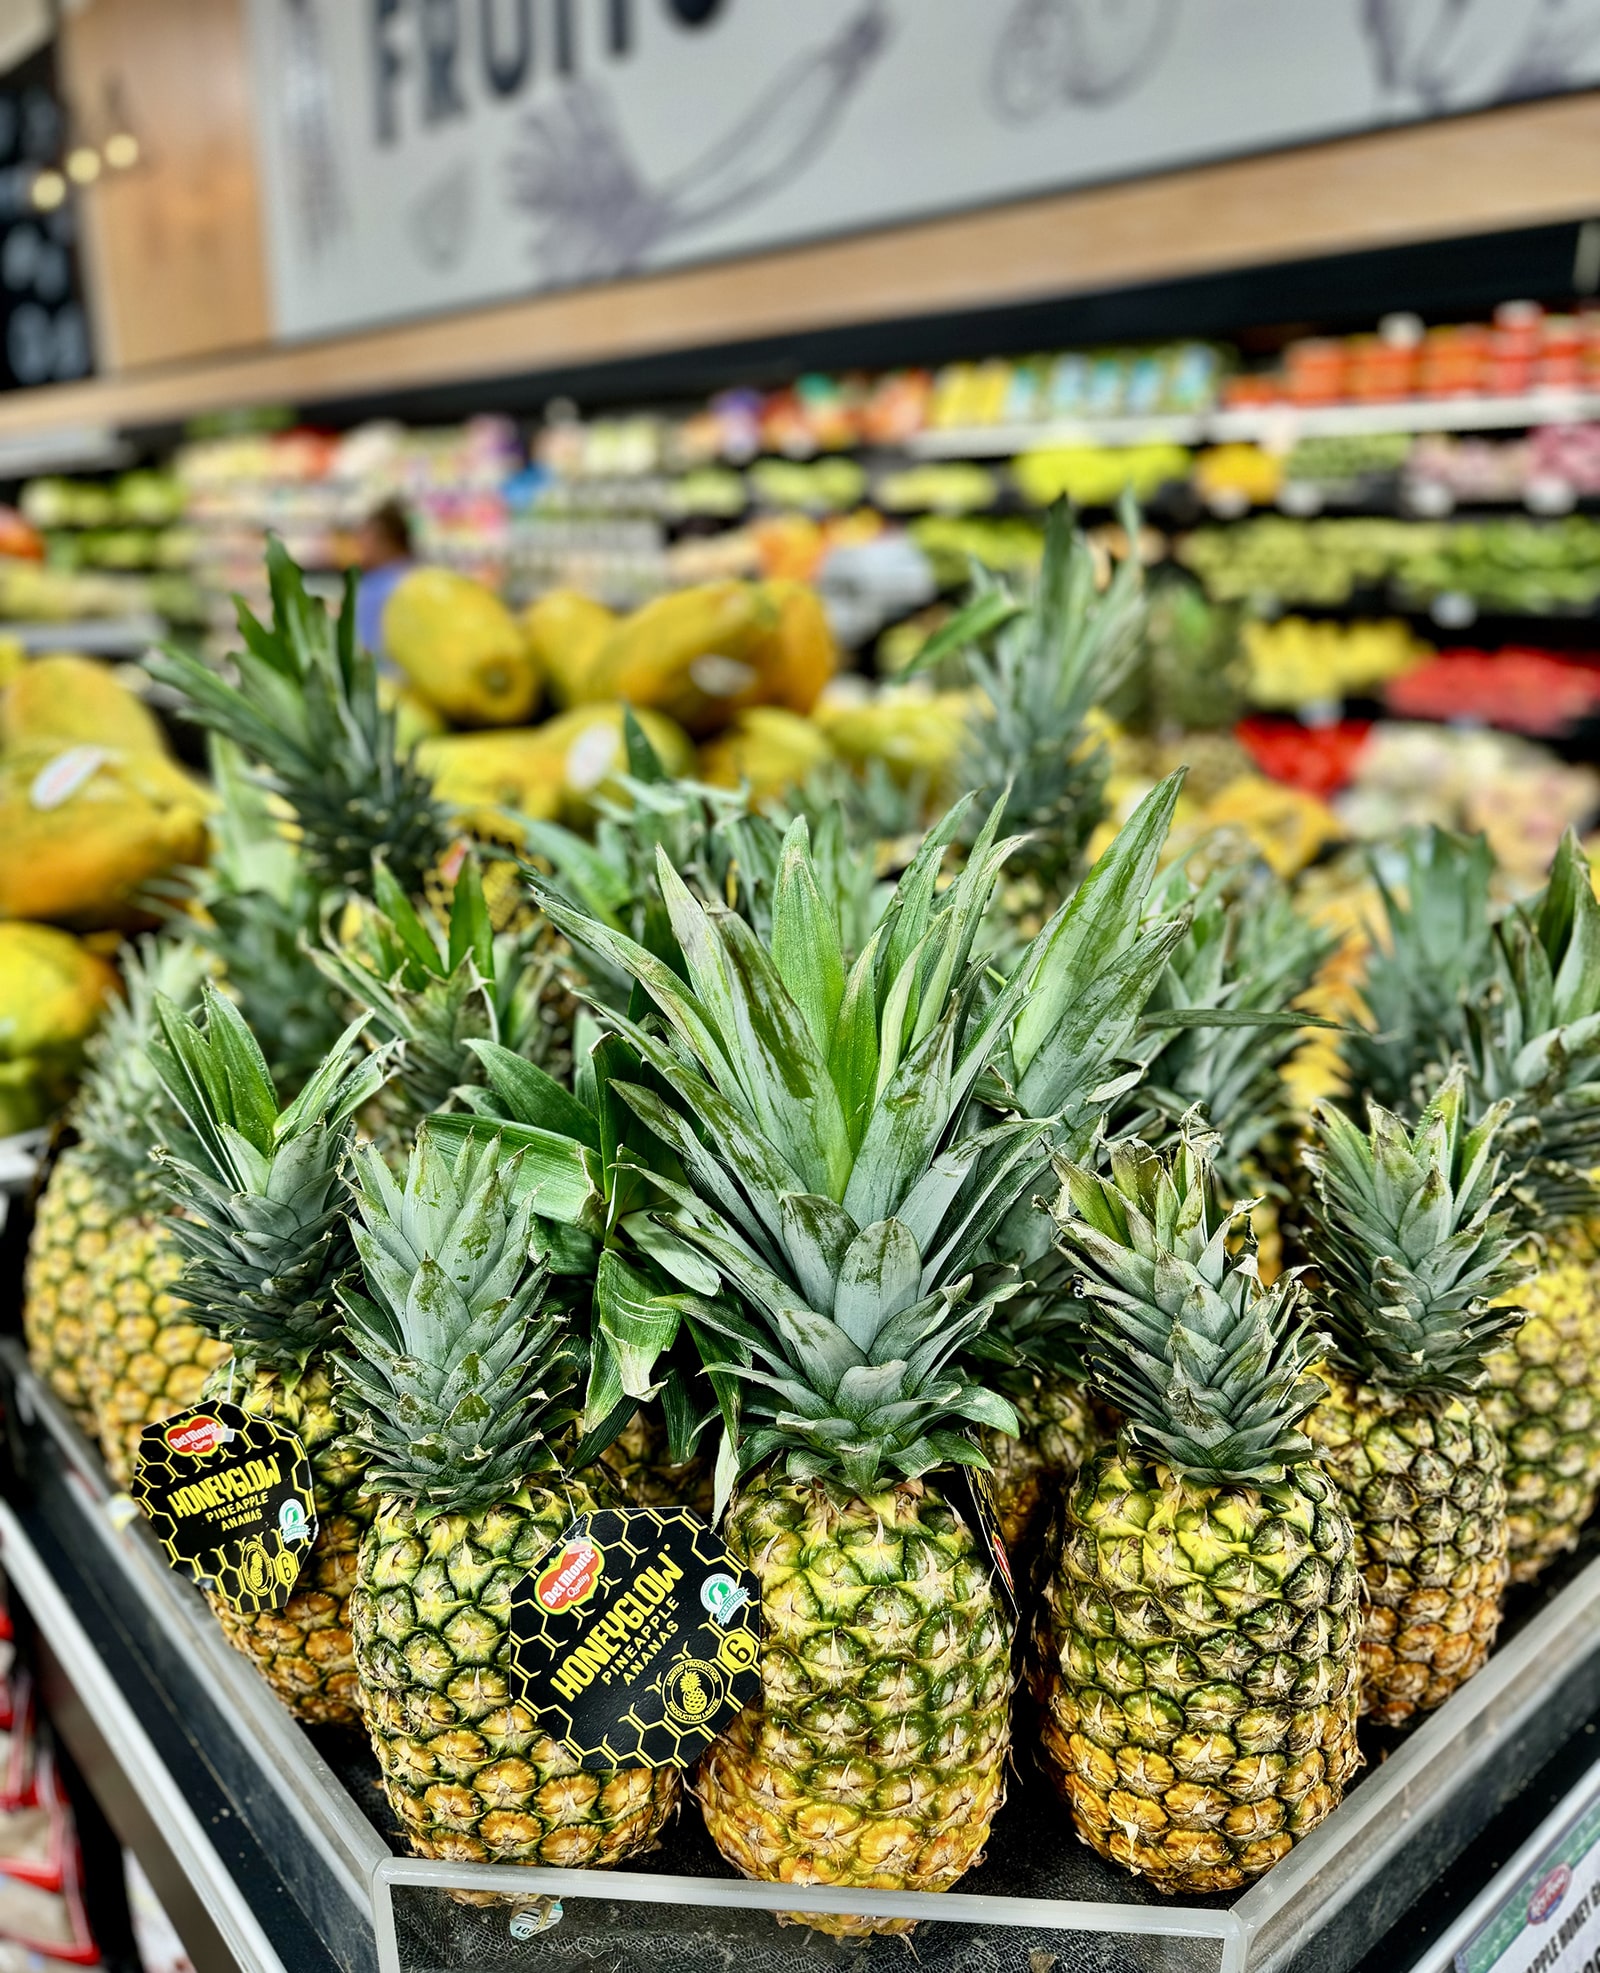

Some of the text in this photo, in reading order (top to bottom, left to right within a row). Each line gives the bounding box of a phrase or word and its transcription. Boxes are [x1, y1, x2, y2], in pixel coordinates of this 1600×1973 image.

[373, 0, 730, 147] FRUI
[170, 1422, 218, 1449] Del Monte
[167, 1455, 282, 1519] HONEYGLOW
[205, 1491, 269, 1522] PINEAPPLE
[221, 1508, 263, 1532] ANANAS
[281, 1556, 292, 1579] 6
[542, 1549, 596, 1607] Del Monte
[566, 1573, 590, 1598] Quality
[550, 1552, 684, 1702] HONEYGLOW
[601, 1596, 680, 1686] PINEAPPLE
[622, 1620, 680, 1687] ANANAS
[726, 1639, 751, 1663] 6
[667, 1661, 720, 1686] LIMITED PRODUCTION
[667, 1700, 701, 1721] PRODUCTION
